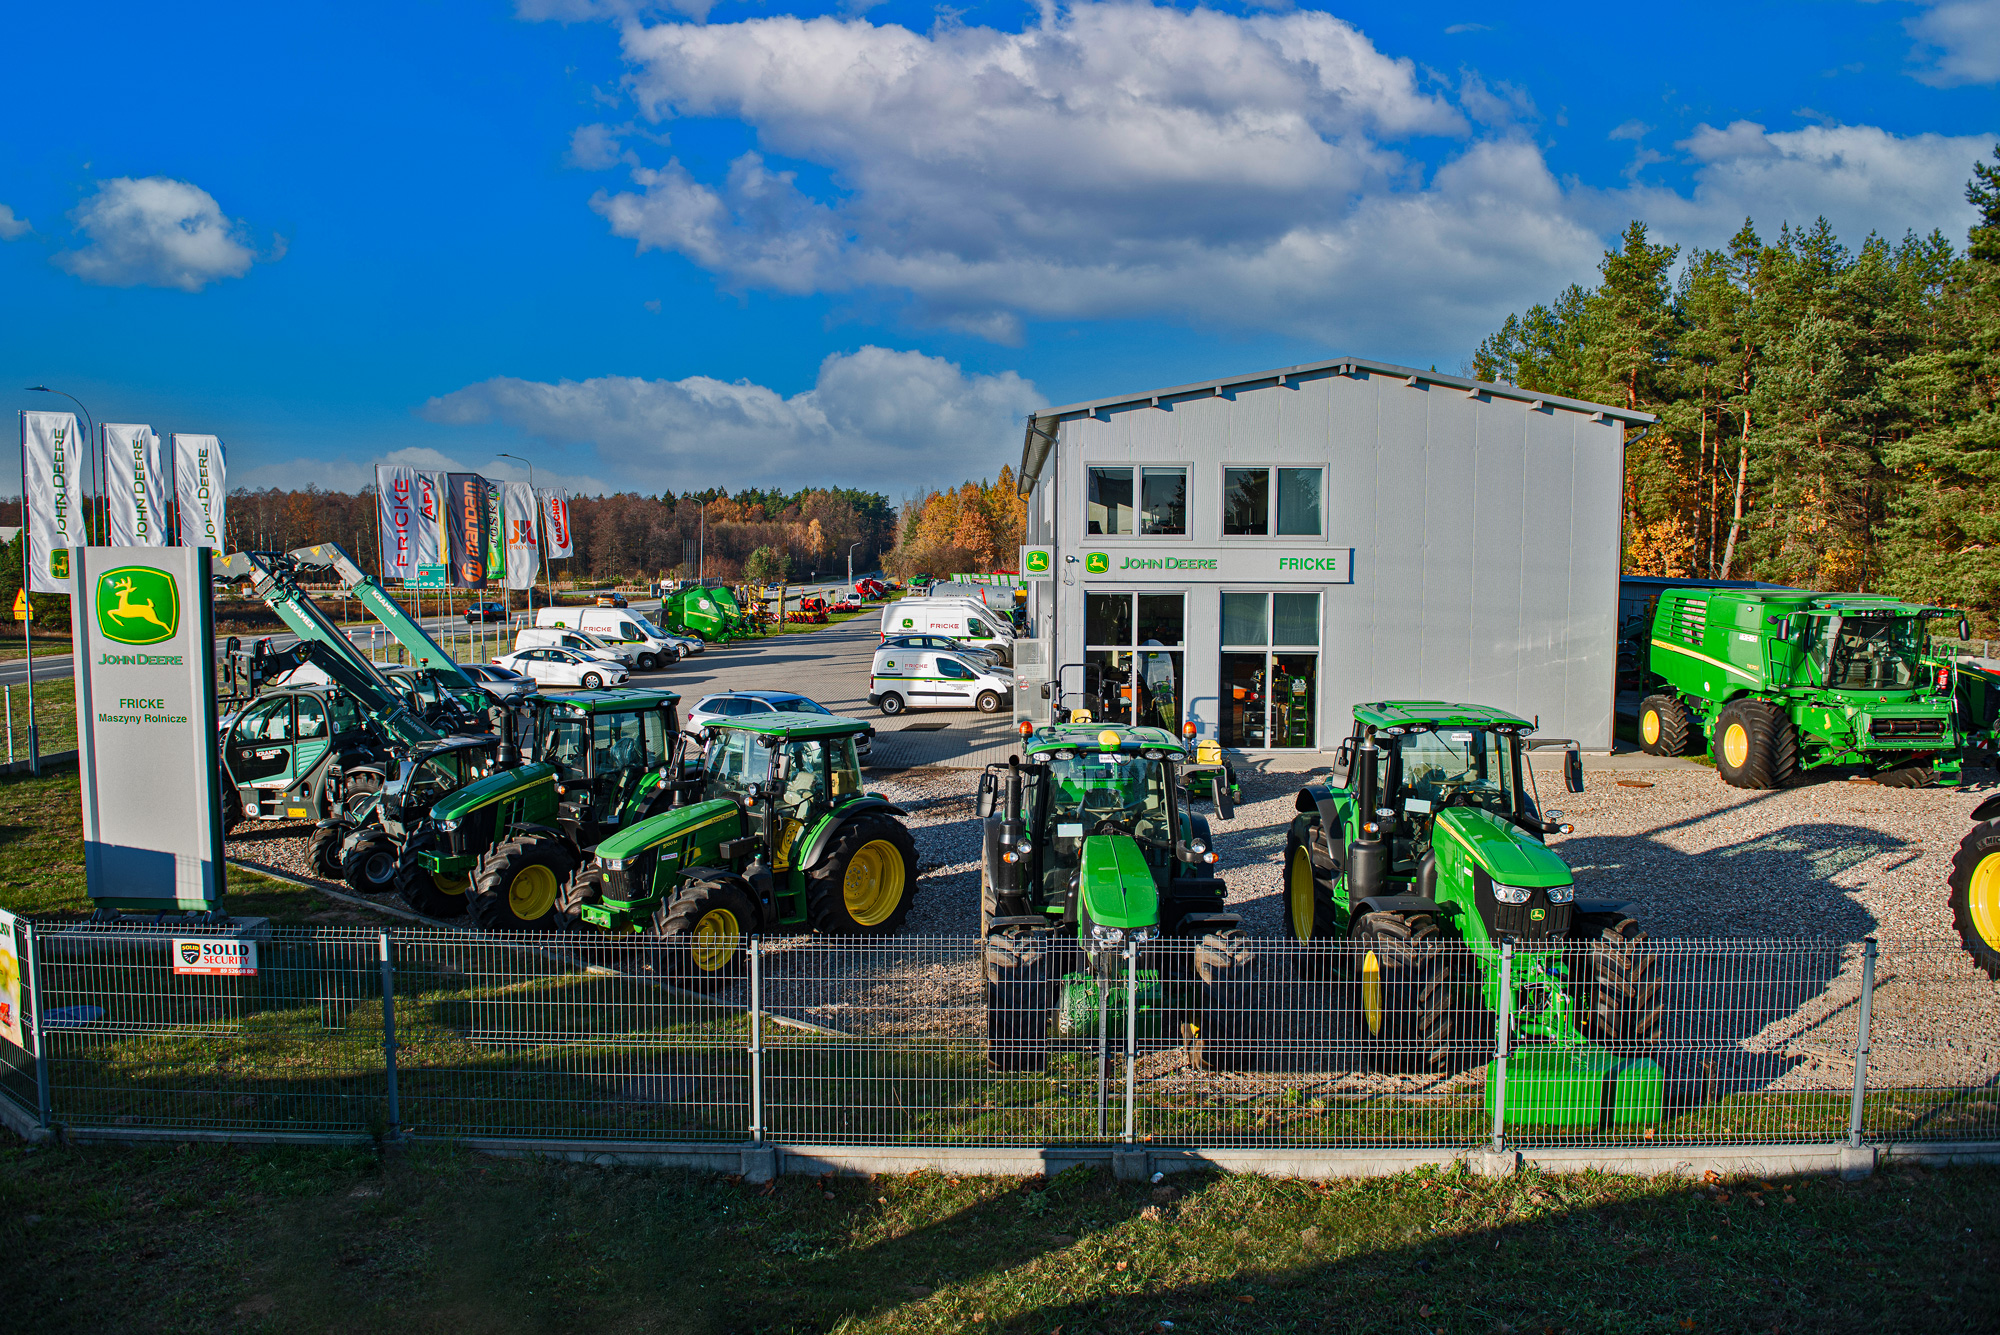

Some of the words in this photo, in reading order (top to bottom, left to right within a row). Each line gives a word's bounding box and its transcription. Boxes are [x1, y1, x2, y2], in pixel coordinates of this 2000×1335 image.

[53, 428, 65, 488] DEERE
[132, 439, 146, 494] DEERE
[198, 448, 209, 501] DEERE
[55, 492, 70, 542] JOHN
[135, 499, 148, 543] JOHN
[394, 479, 409, 567] FRICKE
[488, 483, 499, 549] JOSKIN
[551, 498, 563, 542] MASCHIO
[1120, 556, 1163, 570] JOHN
[1165, 556, 1218, 570] DEERE
[1279, 557, 1336, 571] FRICKE
[286, 597, 315, 630] KRAMER
[371, 589, 398, 618] KRAMER
[98, 653, 136, 665] JOHN
[136, 653, 184, 666] DEERE
[98, 713, 142, 724] Maszyny
[144, 713, 188, 723] Rolnicze
[119, 698, 165, 709] FRICKE
[203, 943, 249, 956] SOLID
[203, 955, 250, 965] SECURITY
